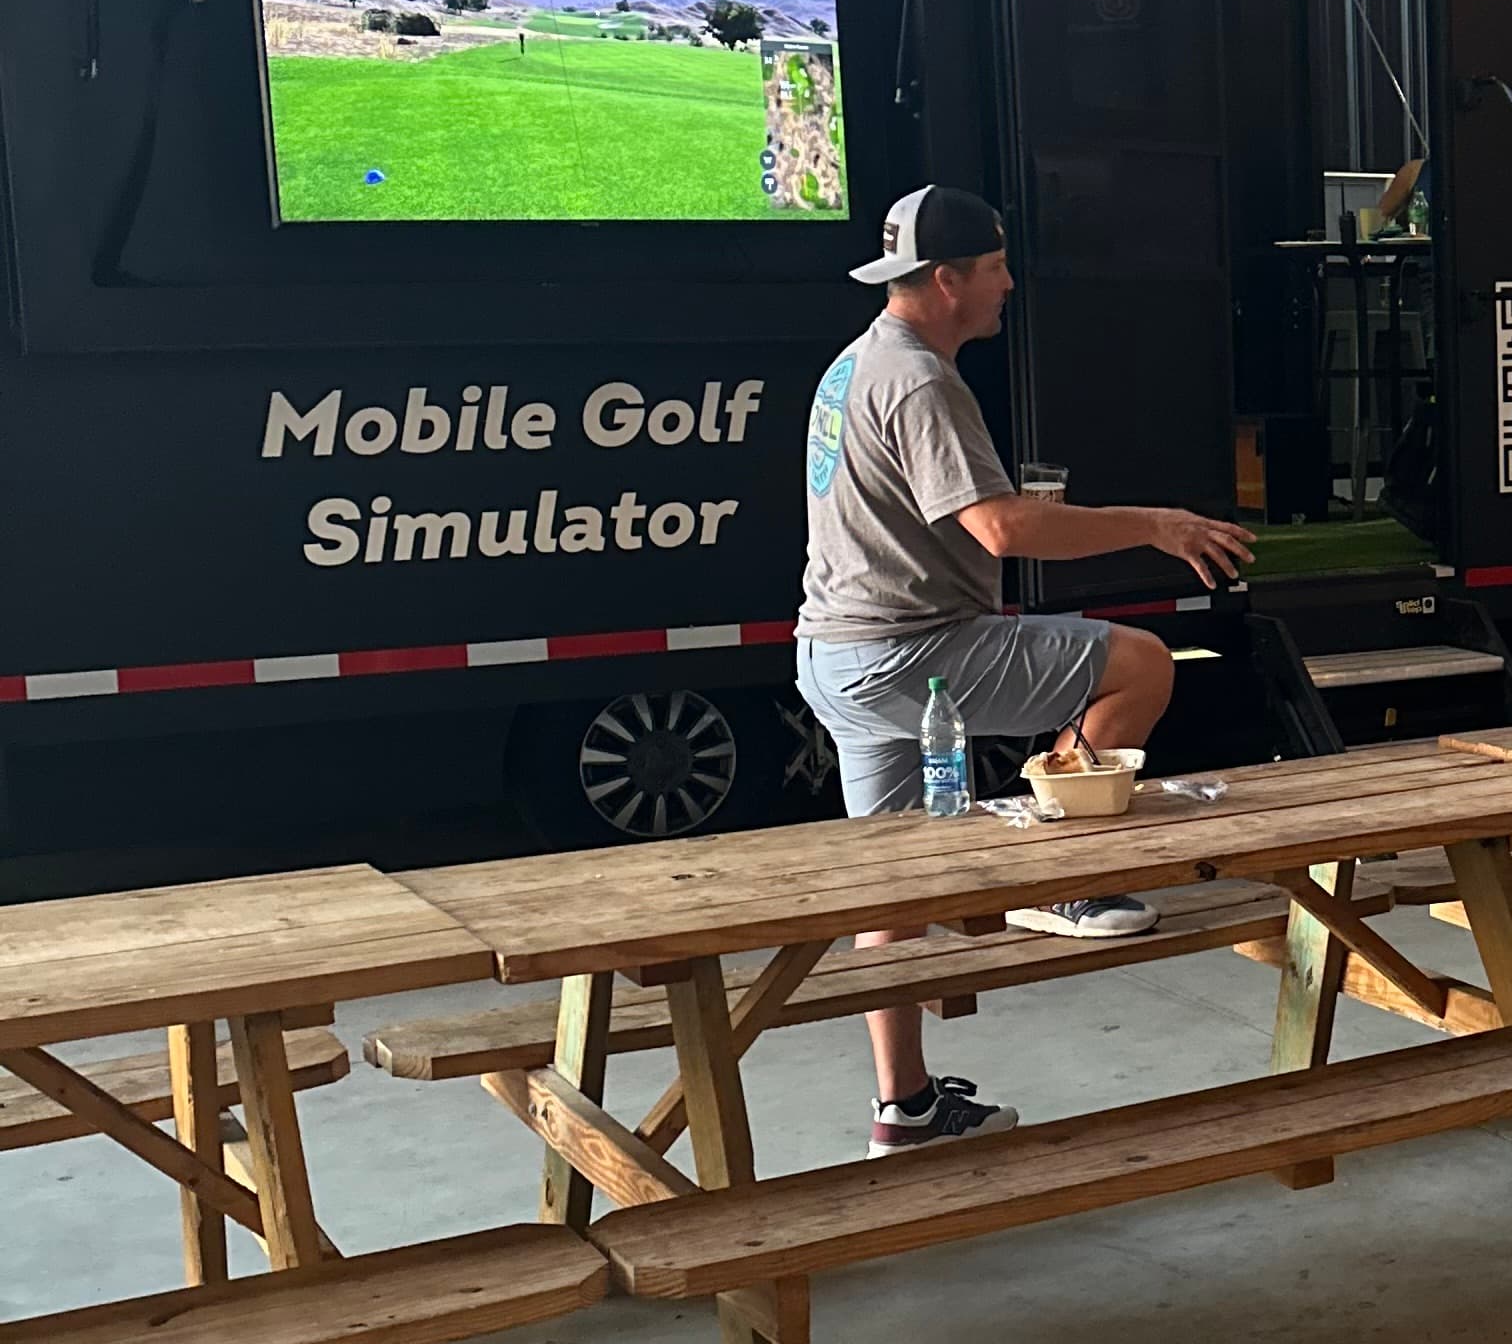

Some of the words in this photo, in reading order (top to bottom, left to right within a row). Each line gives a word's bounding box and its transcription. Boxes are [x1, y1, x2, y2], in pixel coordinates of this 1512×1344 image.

[261, 385, 556, 458] Mobile
[582, 379, 765, 447] Golf
[303, 489, 739, 566] Simulator
[922, 766, 959, 780] 100%
